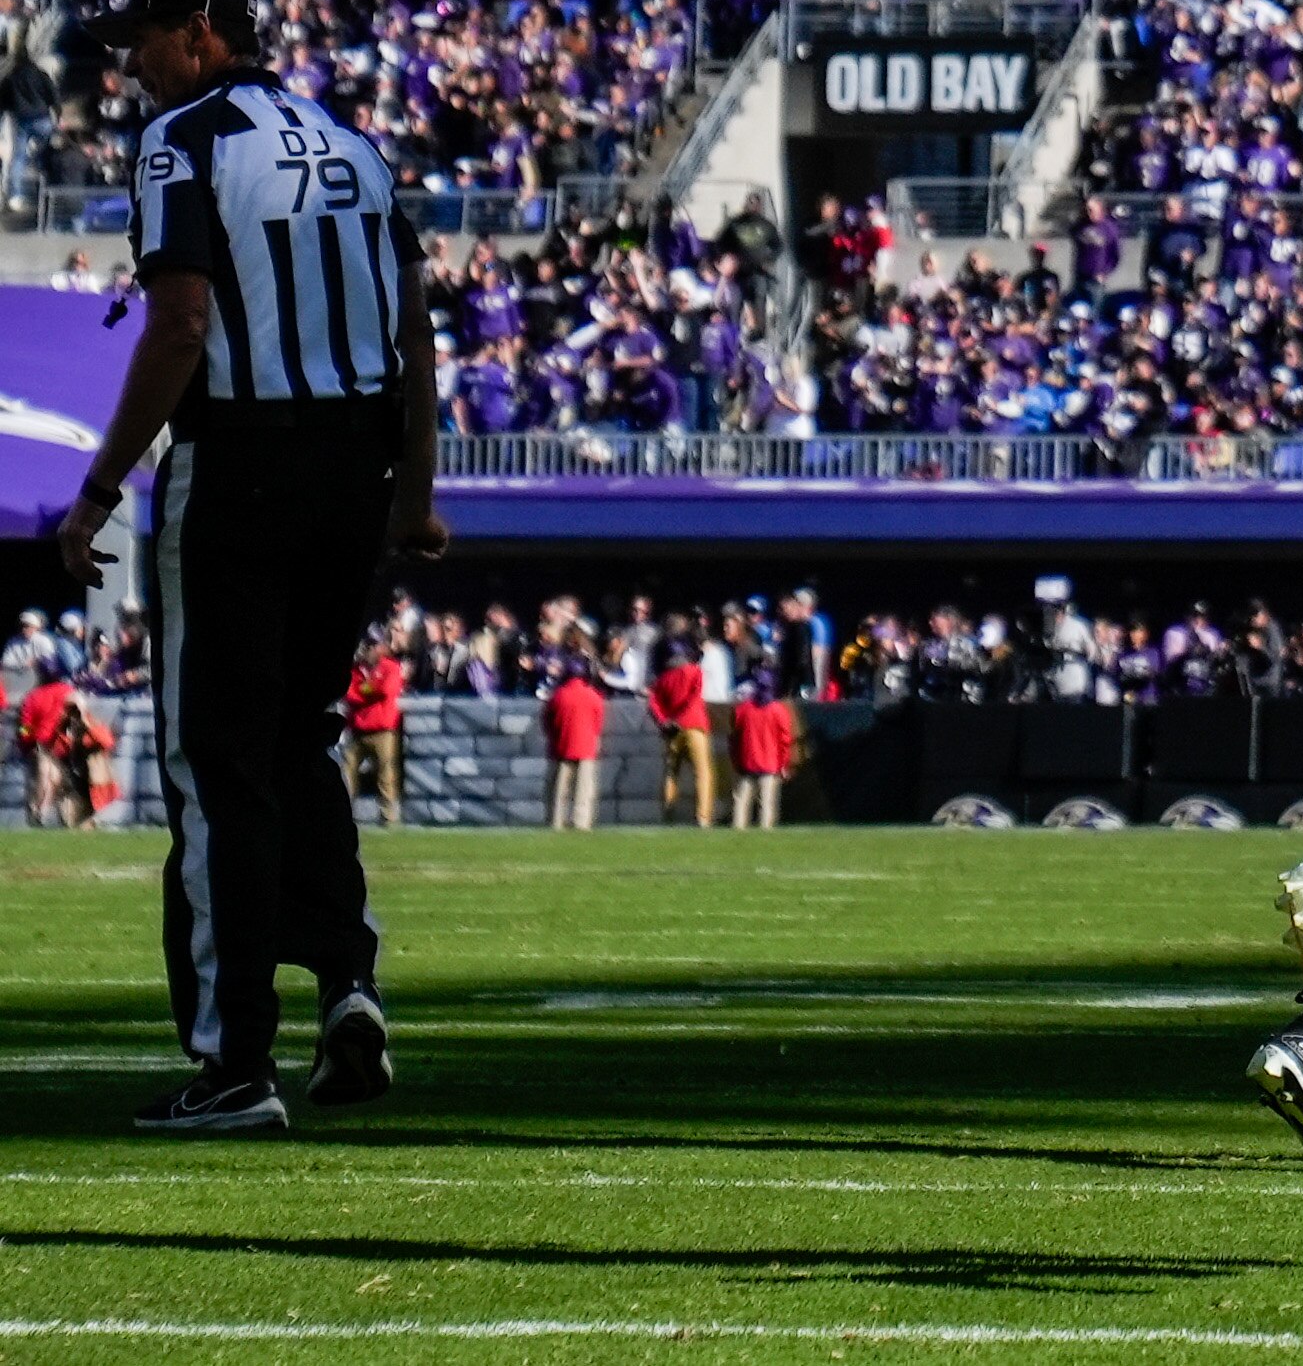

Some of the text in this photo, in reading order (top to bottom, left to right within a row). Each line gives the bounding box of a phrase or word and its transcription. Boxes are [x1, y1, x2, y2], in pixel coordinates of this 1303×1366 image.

[826, 53, 1029, 113] OLD BAY
[278, 129, 330, 157] DJ
[275, 157, 361, 214] 79
